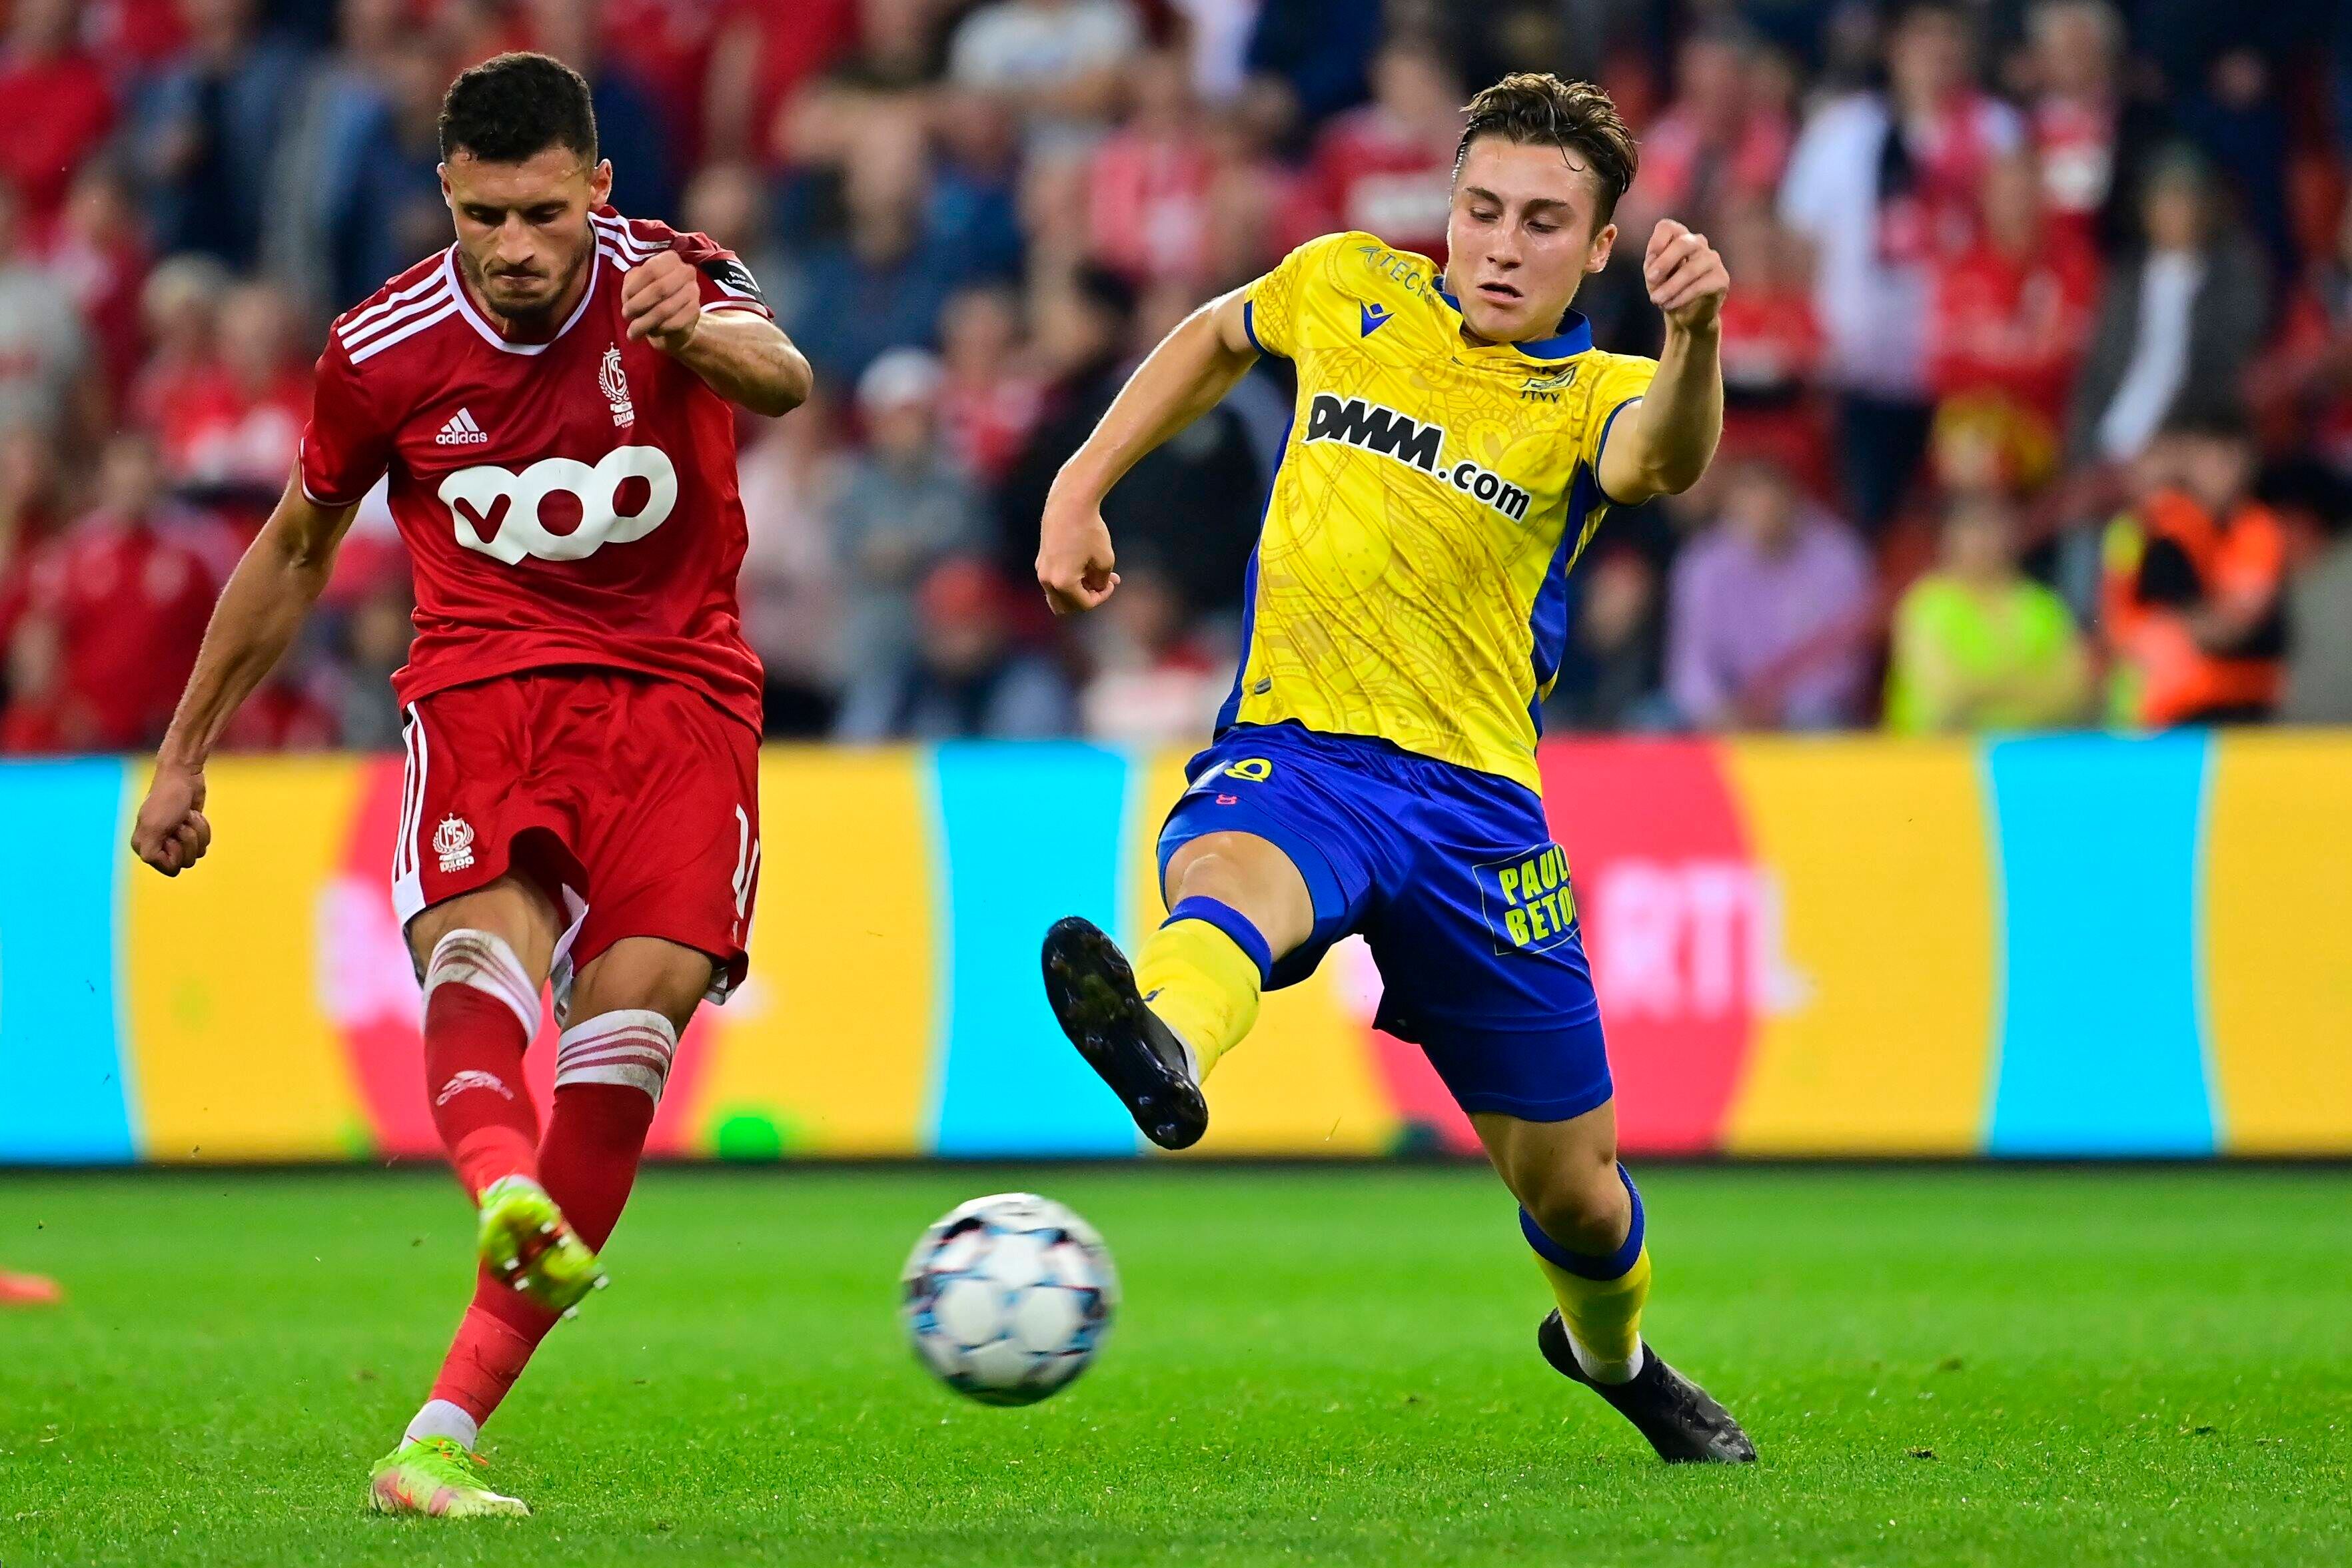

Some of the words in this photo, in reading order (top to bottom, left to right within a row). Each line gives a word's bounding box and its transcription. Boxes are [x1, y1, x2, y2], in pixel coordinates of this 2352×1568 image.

[435, 430, 488, 445] adidas
[1306, 394, 1530, 521] DMM.com
[1504, 886, 1576, 947] BETO
